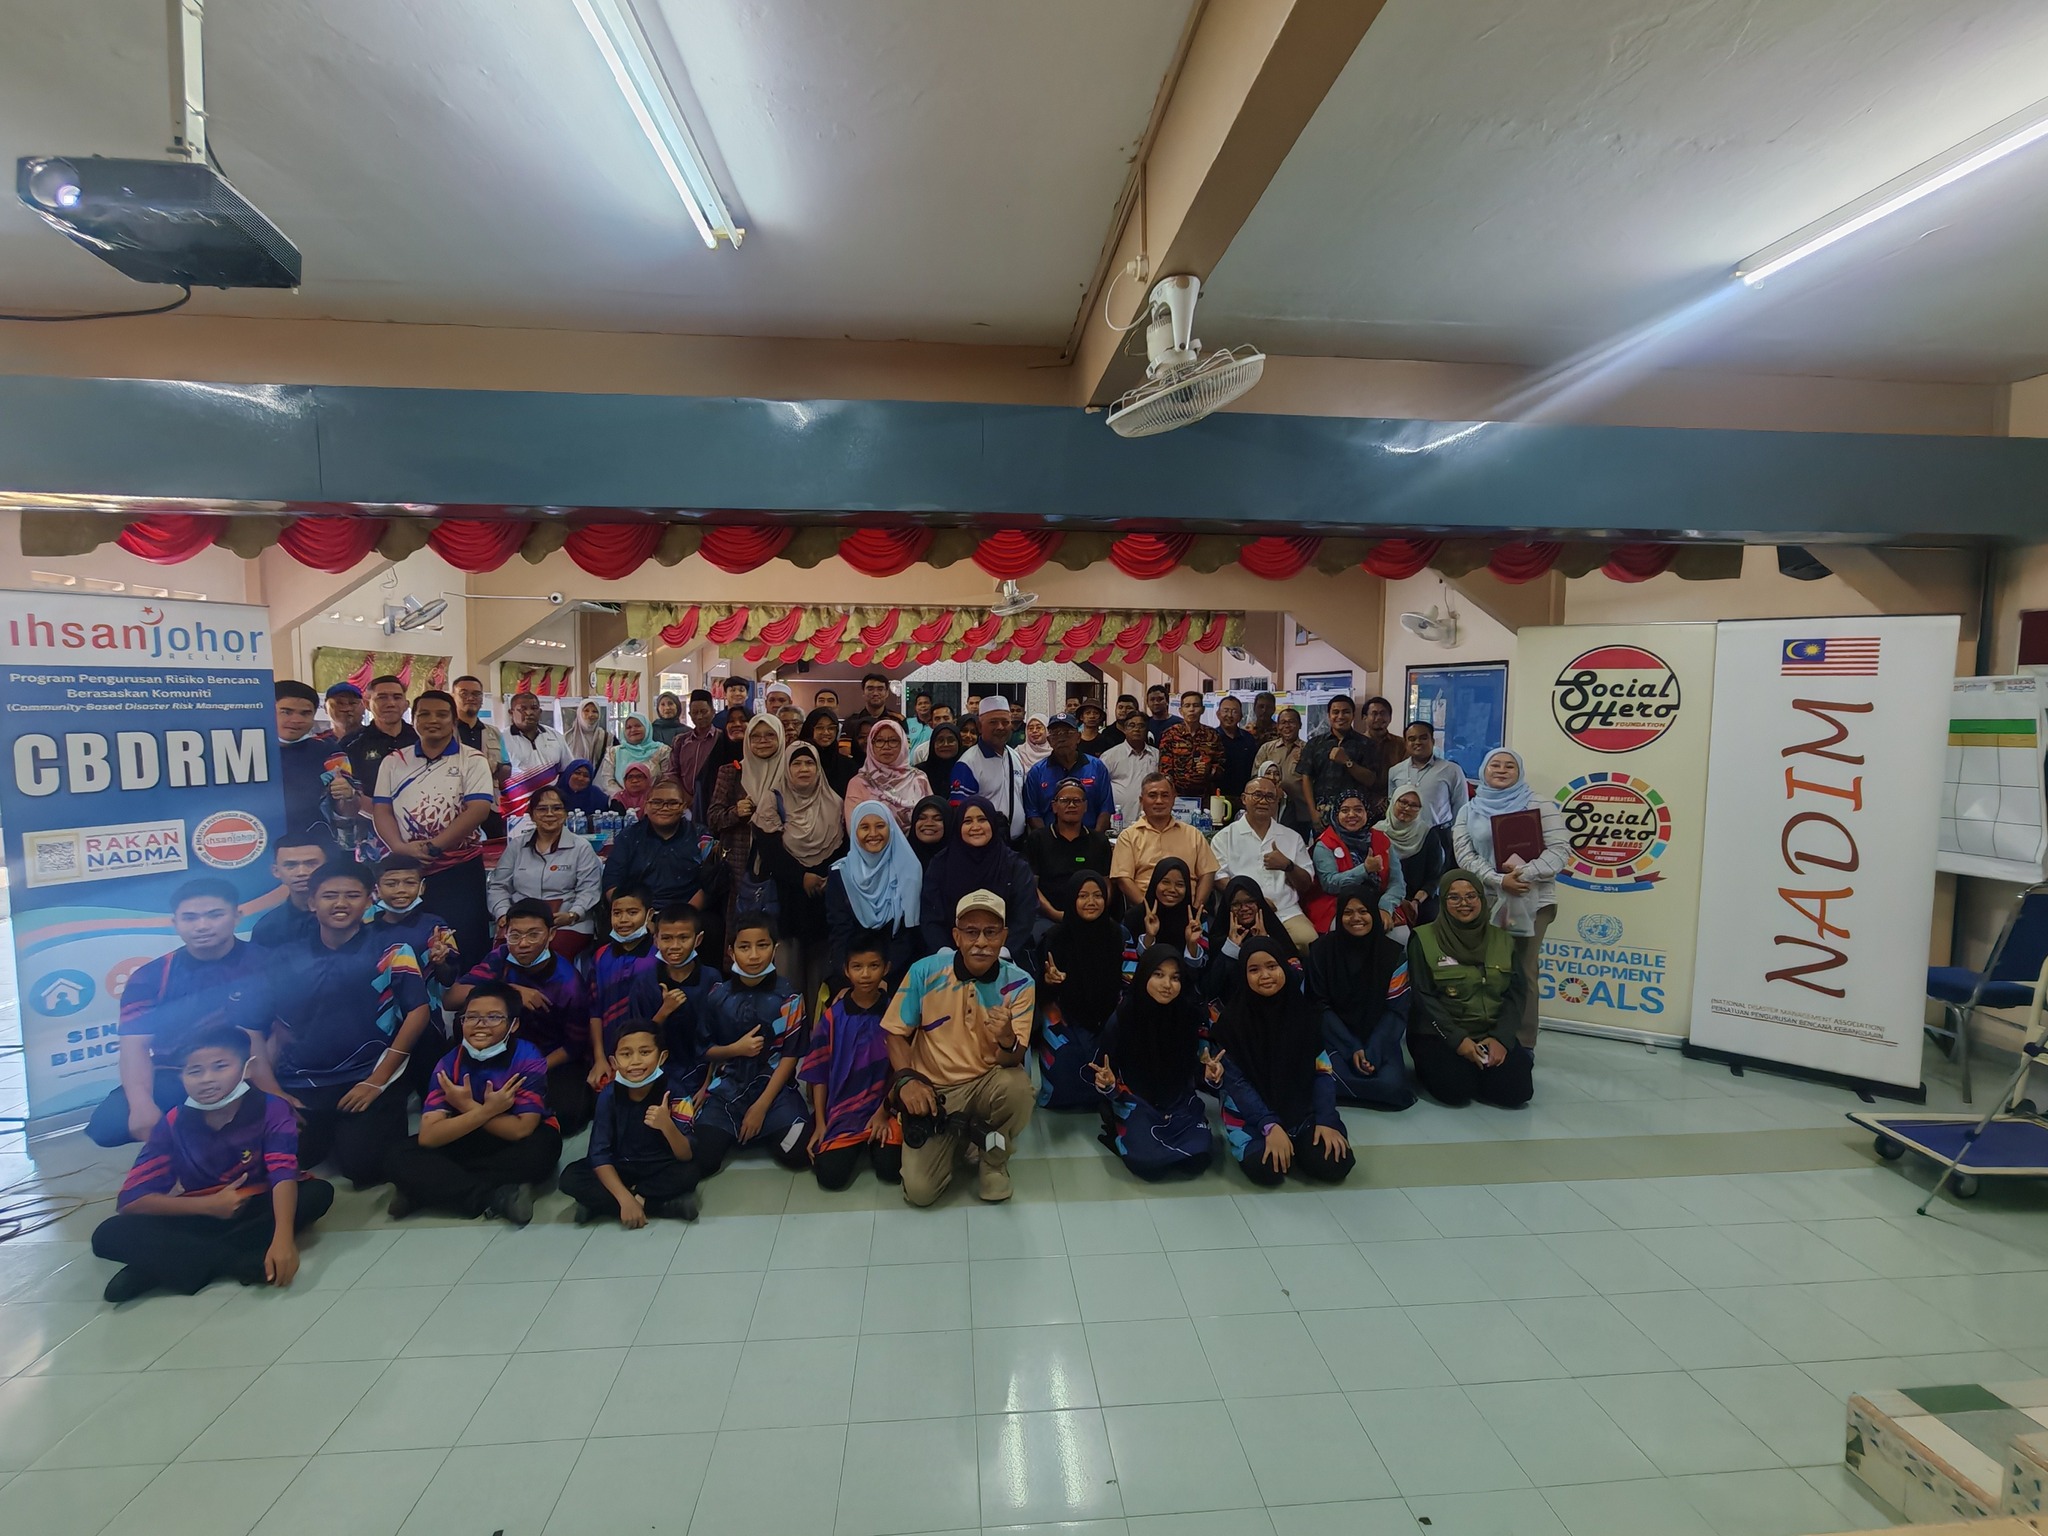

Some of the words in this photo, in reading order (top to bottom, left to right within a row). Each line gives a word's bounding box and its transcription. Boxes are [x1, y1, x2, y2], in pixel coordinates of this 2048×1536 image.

[169, 653, 258, 661] RELIEF
[9, 673, 75, 685] Program
[79, 674, 162, 686] Pengurusan
[166, 675, 204, 684] Risiko
[207, 676, 260, 684] Bencana
[1555, 670, 1675, 711] Social
[66, 689, 148, 698] Berasaskan
[152, 689, 212, 698] Komuniti
[125, 702, 169, 710] Disaster
[195, 702, 264, 711] Management)
[1565, 700, 1680, 734] Hero
[13, 728, 269, 797] CBDRM
[1561, 802, 1652, 832] Social
[86, 831, 179, 852] RAKAN
[1569, 826, 1656, 849] Hero
[1611, 841, 1644, 849] AWARDS
[1765, 698, 1874, 998] NADIM
[88, 846, 181, 867] NADMA
[1538, 973, 1665, 1014] GOALS
[1711, 1005, 1749, 1016] PERSATUAN
[1751, 1011, 1797, 1024] PENGURUSAN
[1799, 1020, 1832, 1030] BENCANA
[67, 1023, 117, 1044] SEN
[51, 1041, 120, 1067] BENC
